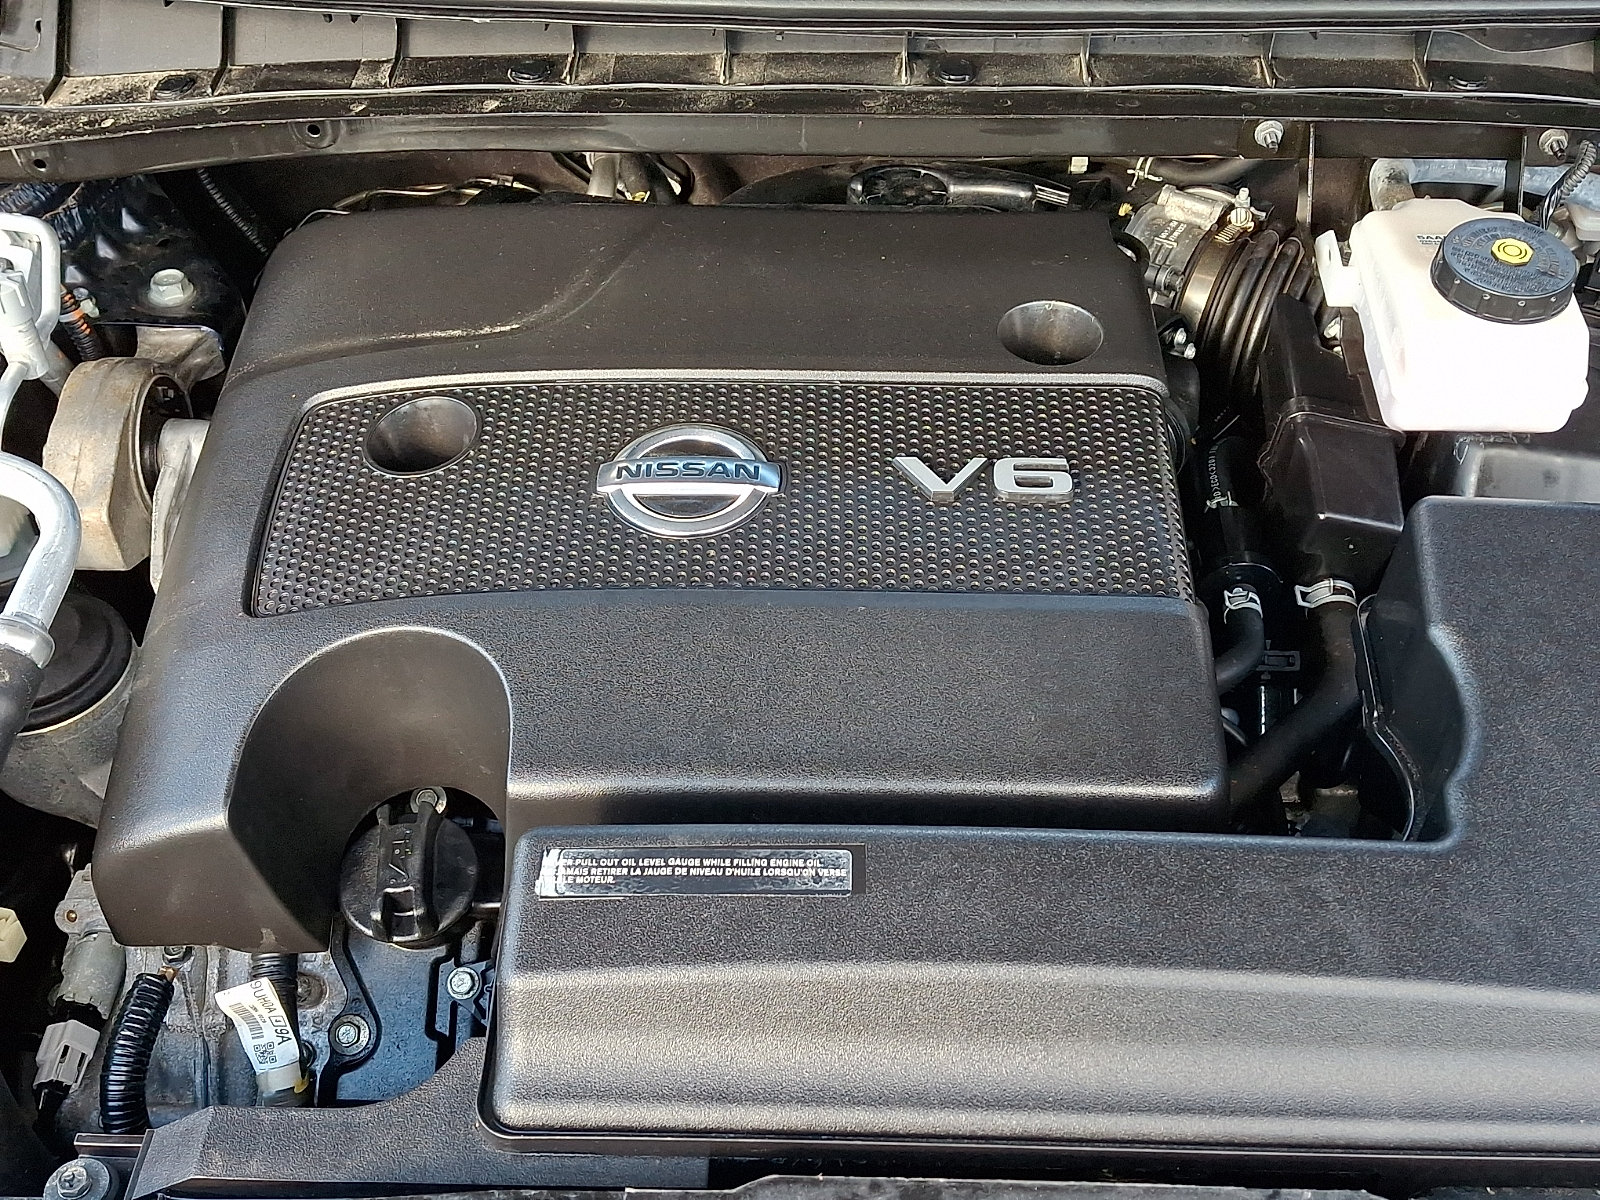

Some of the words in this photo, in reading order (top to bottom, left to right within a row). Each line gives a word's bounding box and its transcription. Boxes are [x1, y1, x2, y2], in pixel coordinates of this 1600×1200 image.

[616, 462, 760, 480] NISSAN
[892, 456, 1074, 503] V6
[575, 858, 597, 866] PULL
[600, 858, 619, 866] OUT
[621, 858, 636, 866] OIL
[638, 858, 666, 866] LEVEL
[668, 858, 700, 866] GAUGE
[702, 858, 731, 866] WHILE
[733, 858, 767, 866] FILLING
[769, 858, 804, 866] ENGINE
[591, 867, 628, 876] RETIRER
[630, 867, 641, 876] LA
[642, 867, 672, 876] JAUGE
[674, 867, 687, 876] DE
[689, 867, 723, 876] NIVEAU
[725, 867, 760, 876] D'HUILE
[762, 867, 816, 876] LORSQU'ON
[817, 867, 847, 876] VERSE
[275, 1028, 292, 1046] 9A
